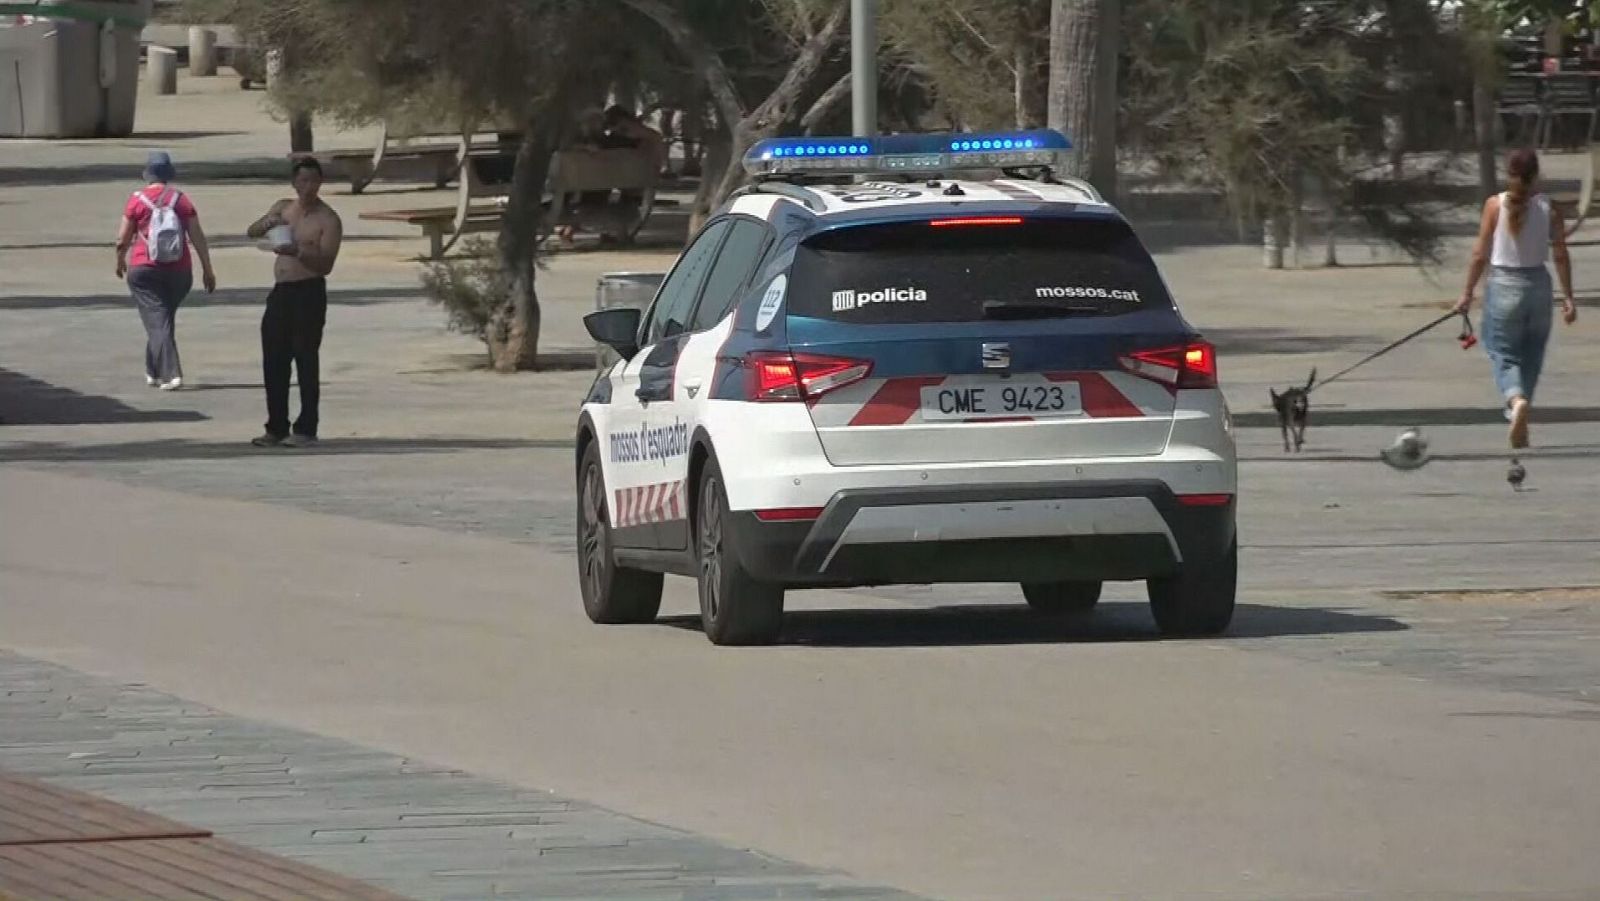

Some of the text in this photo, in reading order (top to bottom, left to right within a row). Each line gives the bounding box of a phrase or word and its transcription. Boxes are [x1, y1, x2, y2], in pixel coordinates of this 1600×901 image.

[857, 287, 927, 307] policia
[1035, 286, 1141, 303] mossos.cat
[938, 386, 1065, 414] CME 9423
[610, 431, 640, 463] mossos
